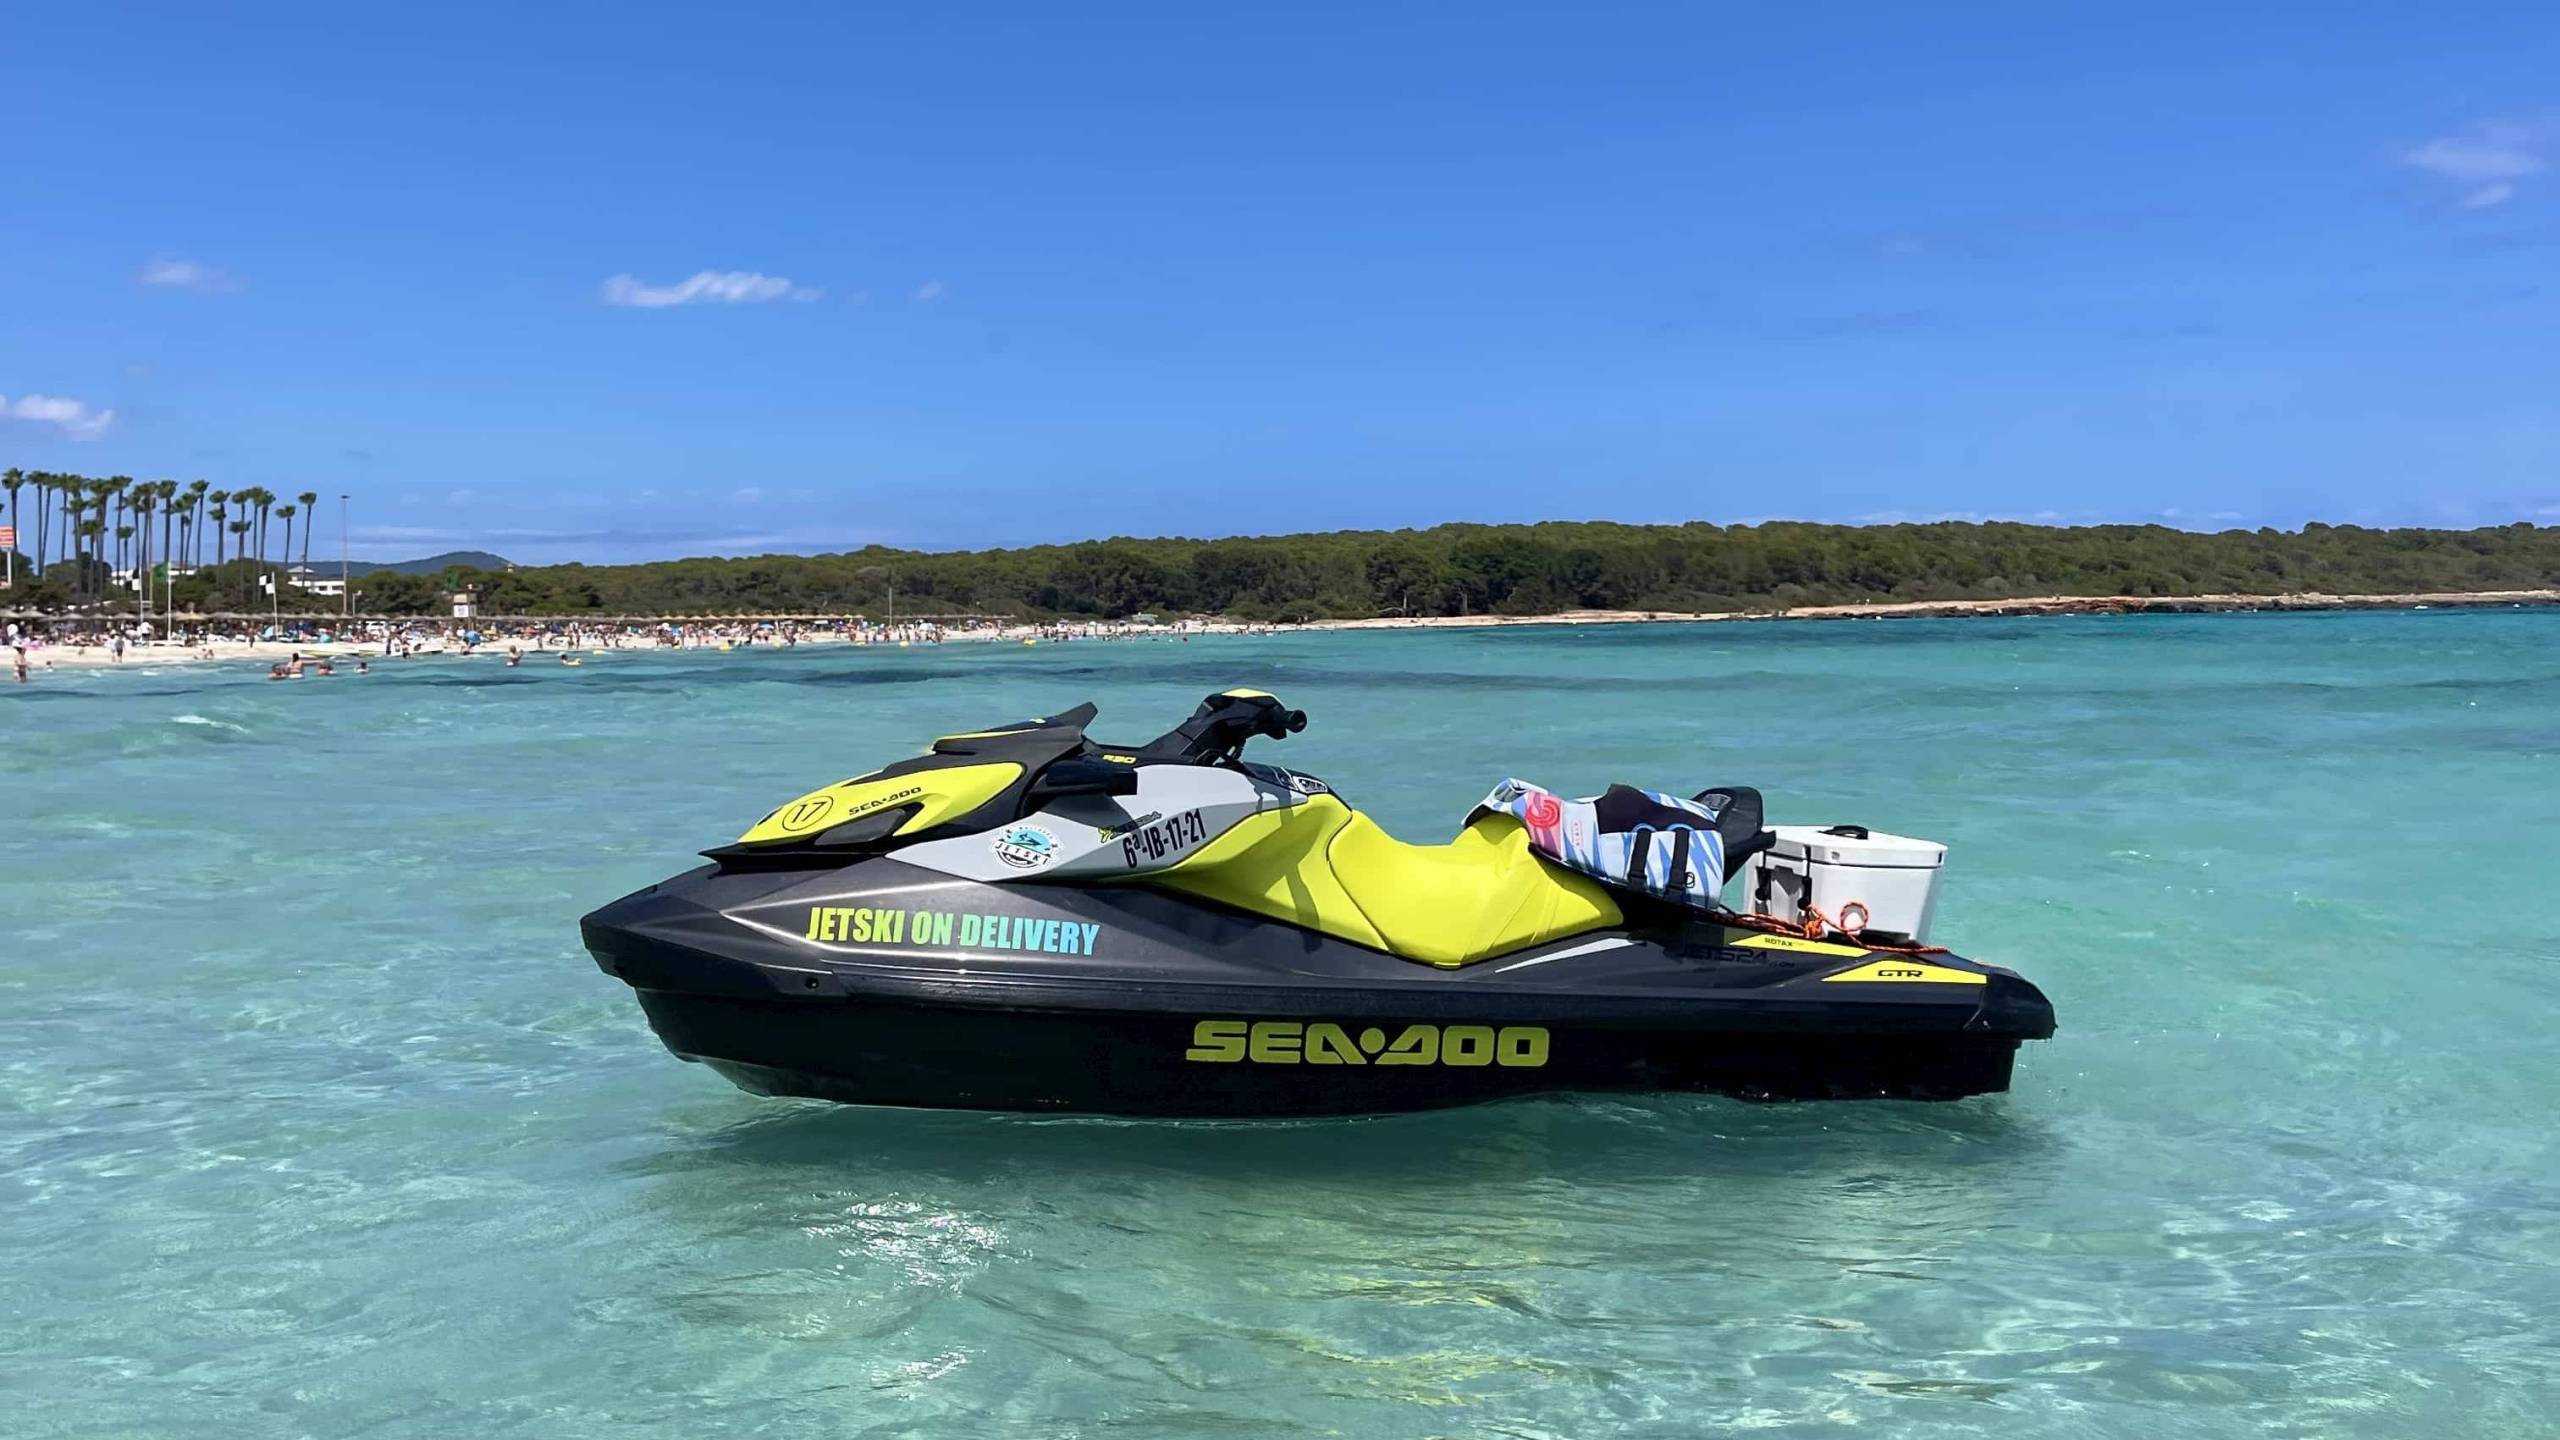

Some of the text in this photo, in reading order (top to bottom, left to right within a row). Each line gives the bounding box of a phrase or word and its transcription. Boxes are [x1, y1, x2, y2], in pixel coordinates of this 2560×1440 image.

[791, 800, 828, 823] 17
[995, 842, 1048, 865] JETSKI
[805, 906, 1100, 955] JETSKI ON DELIVERY
[1764, 937, 1793, 947] ROTAX
[1877, 969, 1923, 978] GTR
